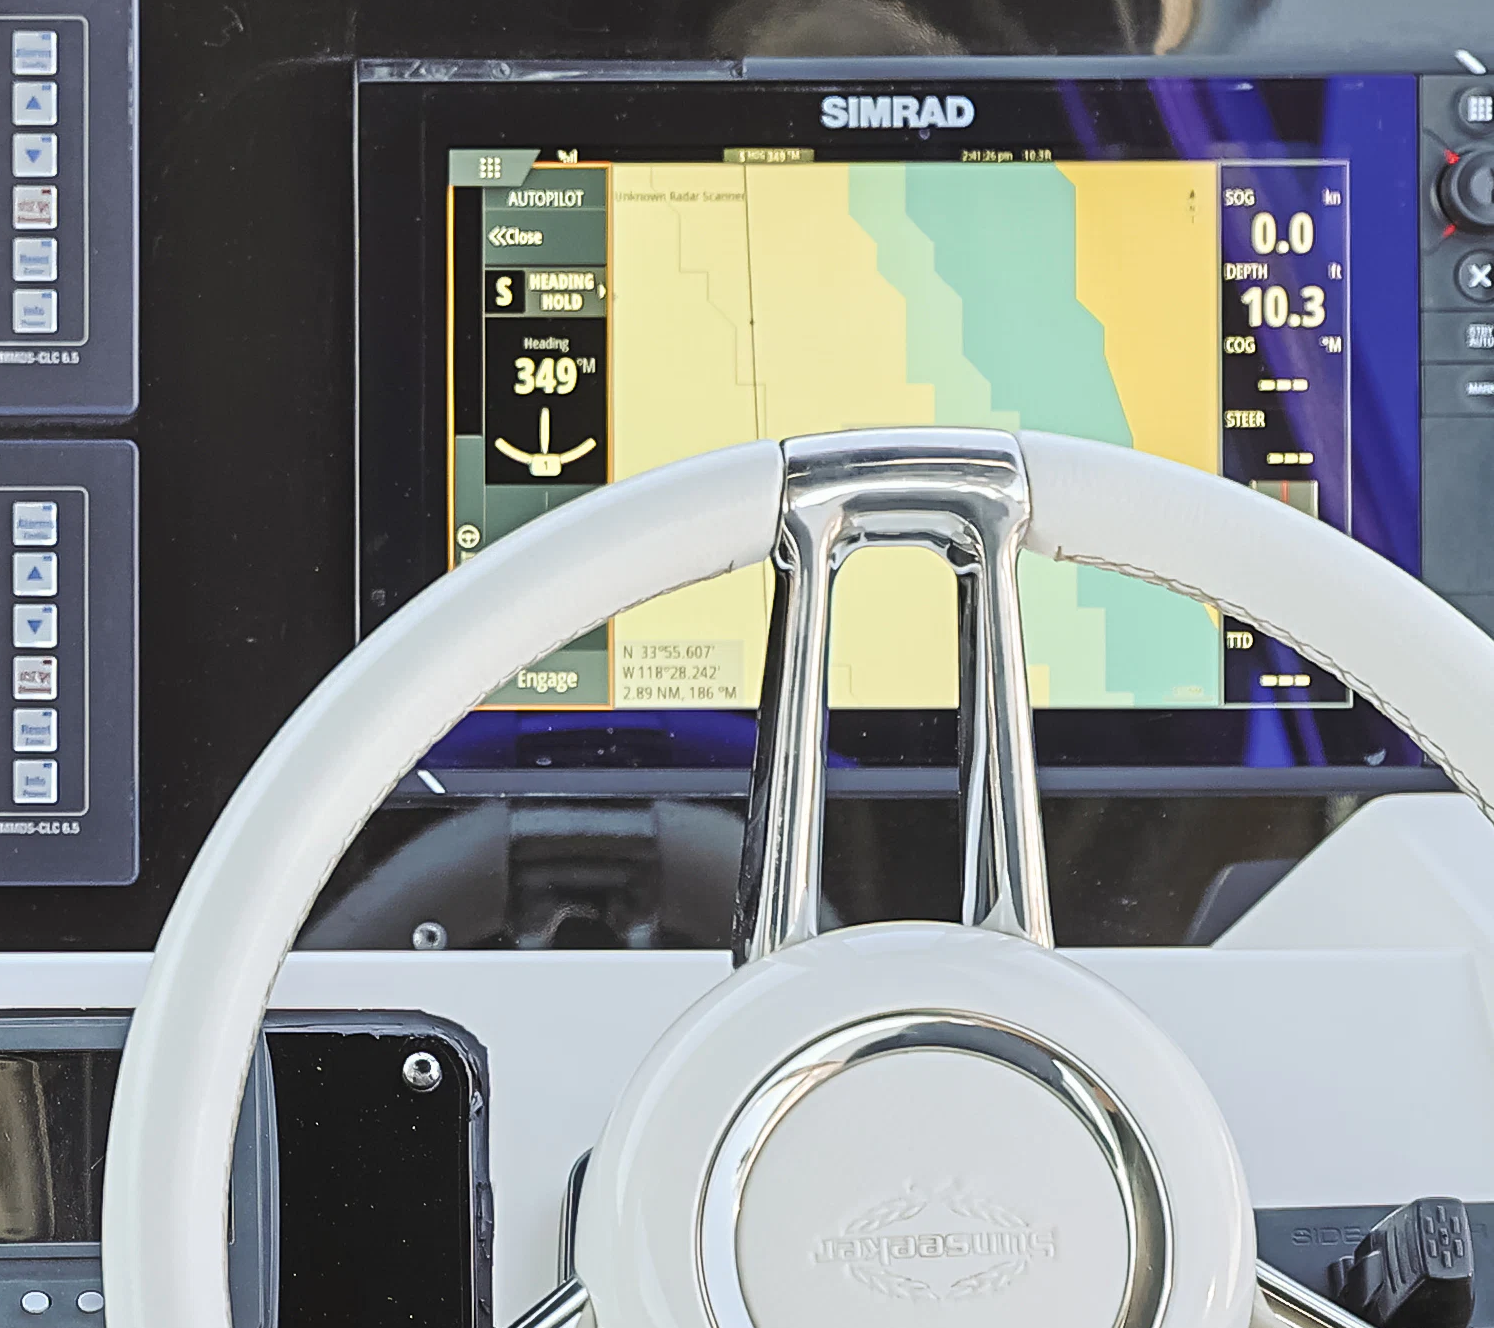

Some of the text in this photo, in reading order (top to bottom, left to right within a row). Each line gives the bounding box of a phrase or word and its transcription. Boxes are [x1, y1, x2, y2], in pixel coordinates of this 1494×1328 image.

[821, 96, 974, 128] SIMRAD
[508, 190, 584, 208] AUTOPILOT
[1225, 188, 1341, 207] SOG kn
[1251, 212, 1314, 255] 0.0
[1224, 262, 1342, 281] DEPTH ft
[529, 272, 595, 292] HEADING
[496, 276, 513, 307] S
[542, 293, 583, 311] HOLD
[1241, 286, 1326, 329] 10.3
[524, 336, 570, 353] Heading
[1224, 336, 1256, 354] COG
[513, 358, 578, 396] 349
[1225, 410, 1266, 428] STEER
[1226, 631, 1254, 649] TTD
[623, 645, 633, 660] N
[516, 670, 578, 691] Engage
[623, 666, 637, 680] W
[623, 686, 653, 701] 2.89
[689, 686, 714, 701] 186
